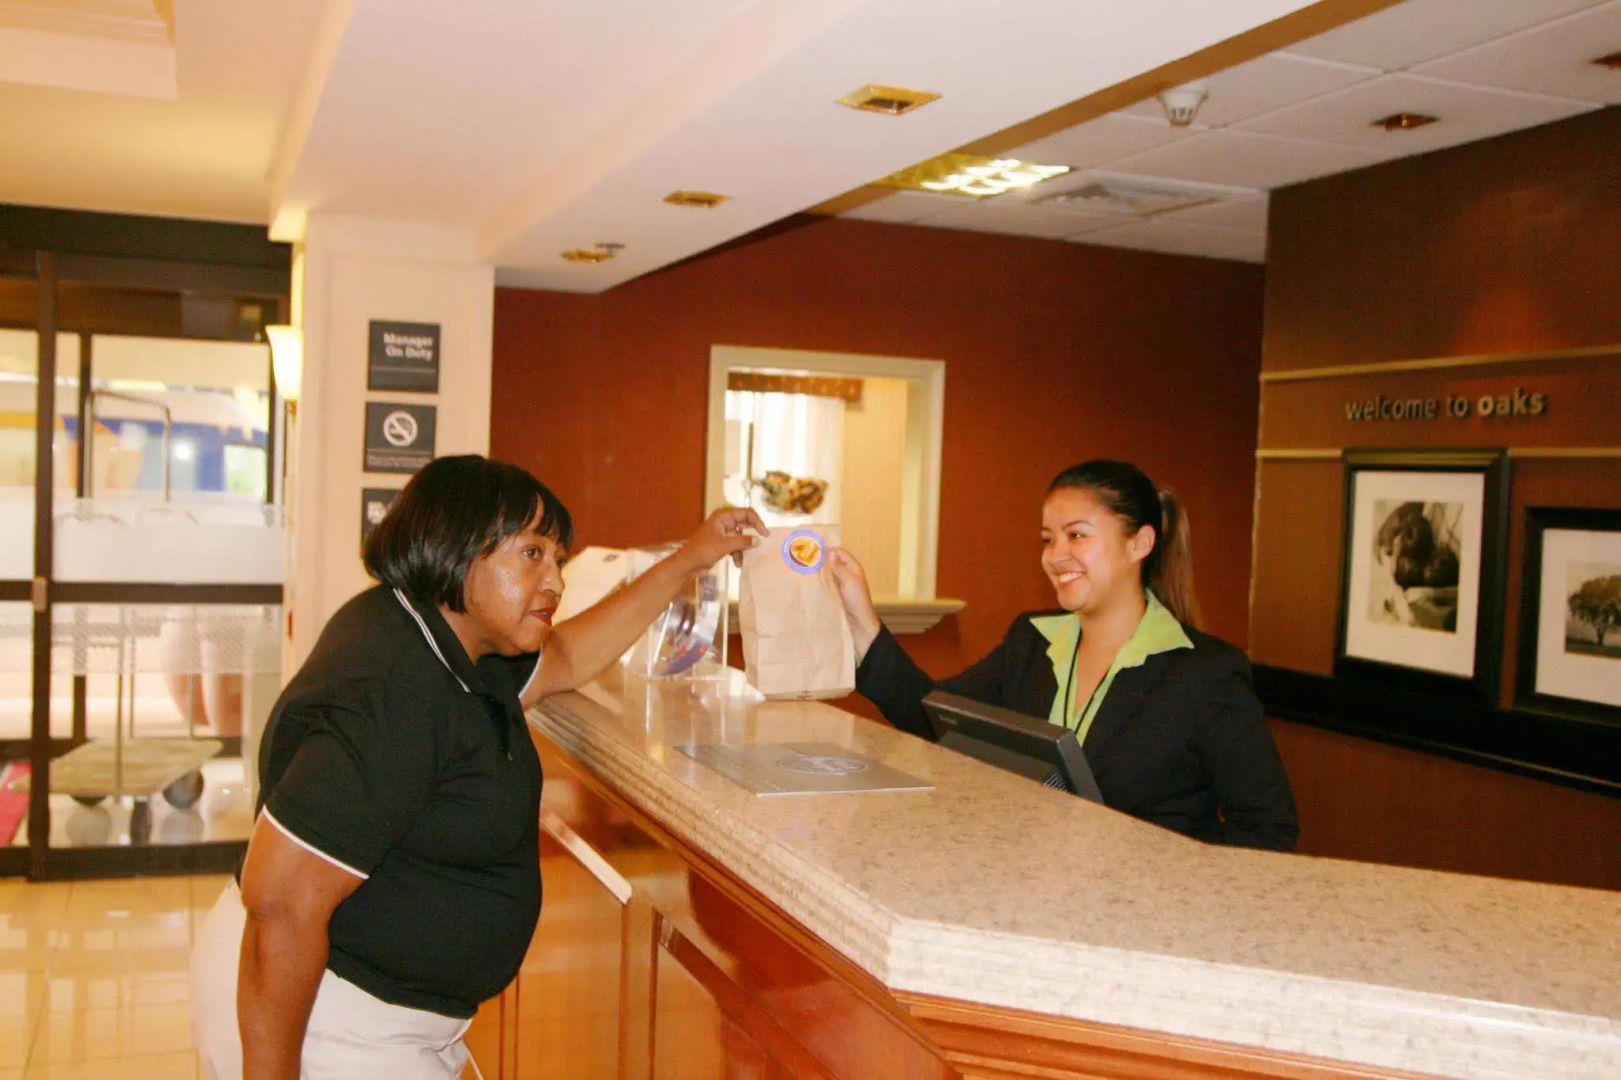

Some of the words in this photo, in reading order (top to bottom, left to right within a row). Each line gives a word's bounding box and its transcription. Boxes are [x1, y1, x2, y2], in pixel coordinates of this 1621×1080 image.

[384, 331, 433, 348] Manager
[386, 345, 403, 358] On
[405, 346, 433, 361] Duty
[1346, 395, 1437, 421] welcome
[1447, 397, 1469, 418] to
[1477, 387, 1546, 416] oaks
